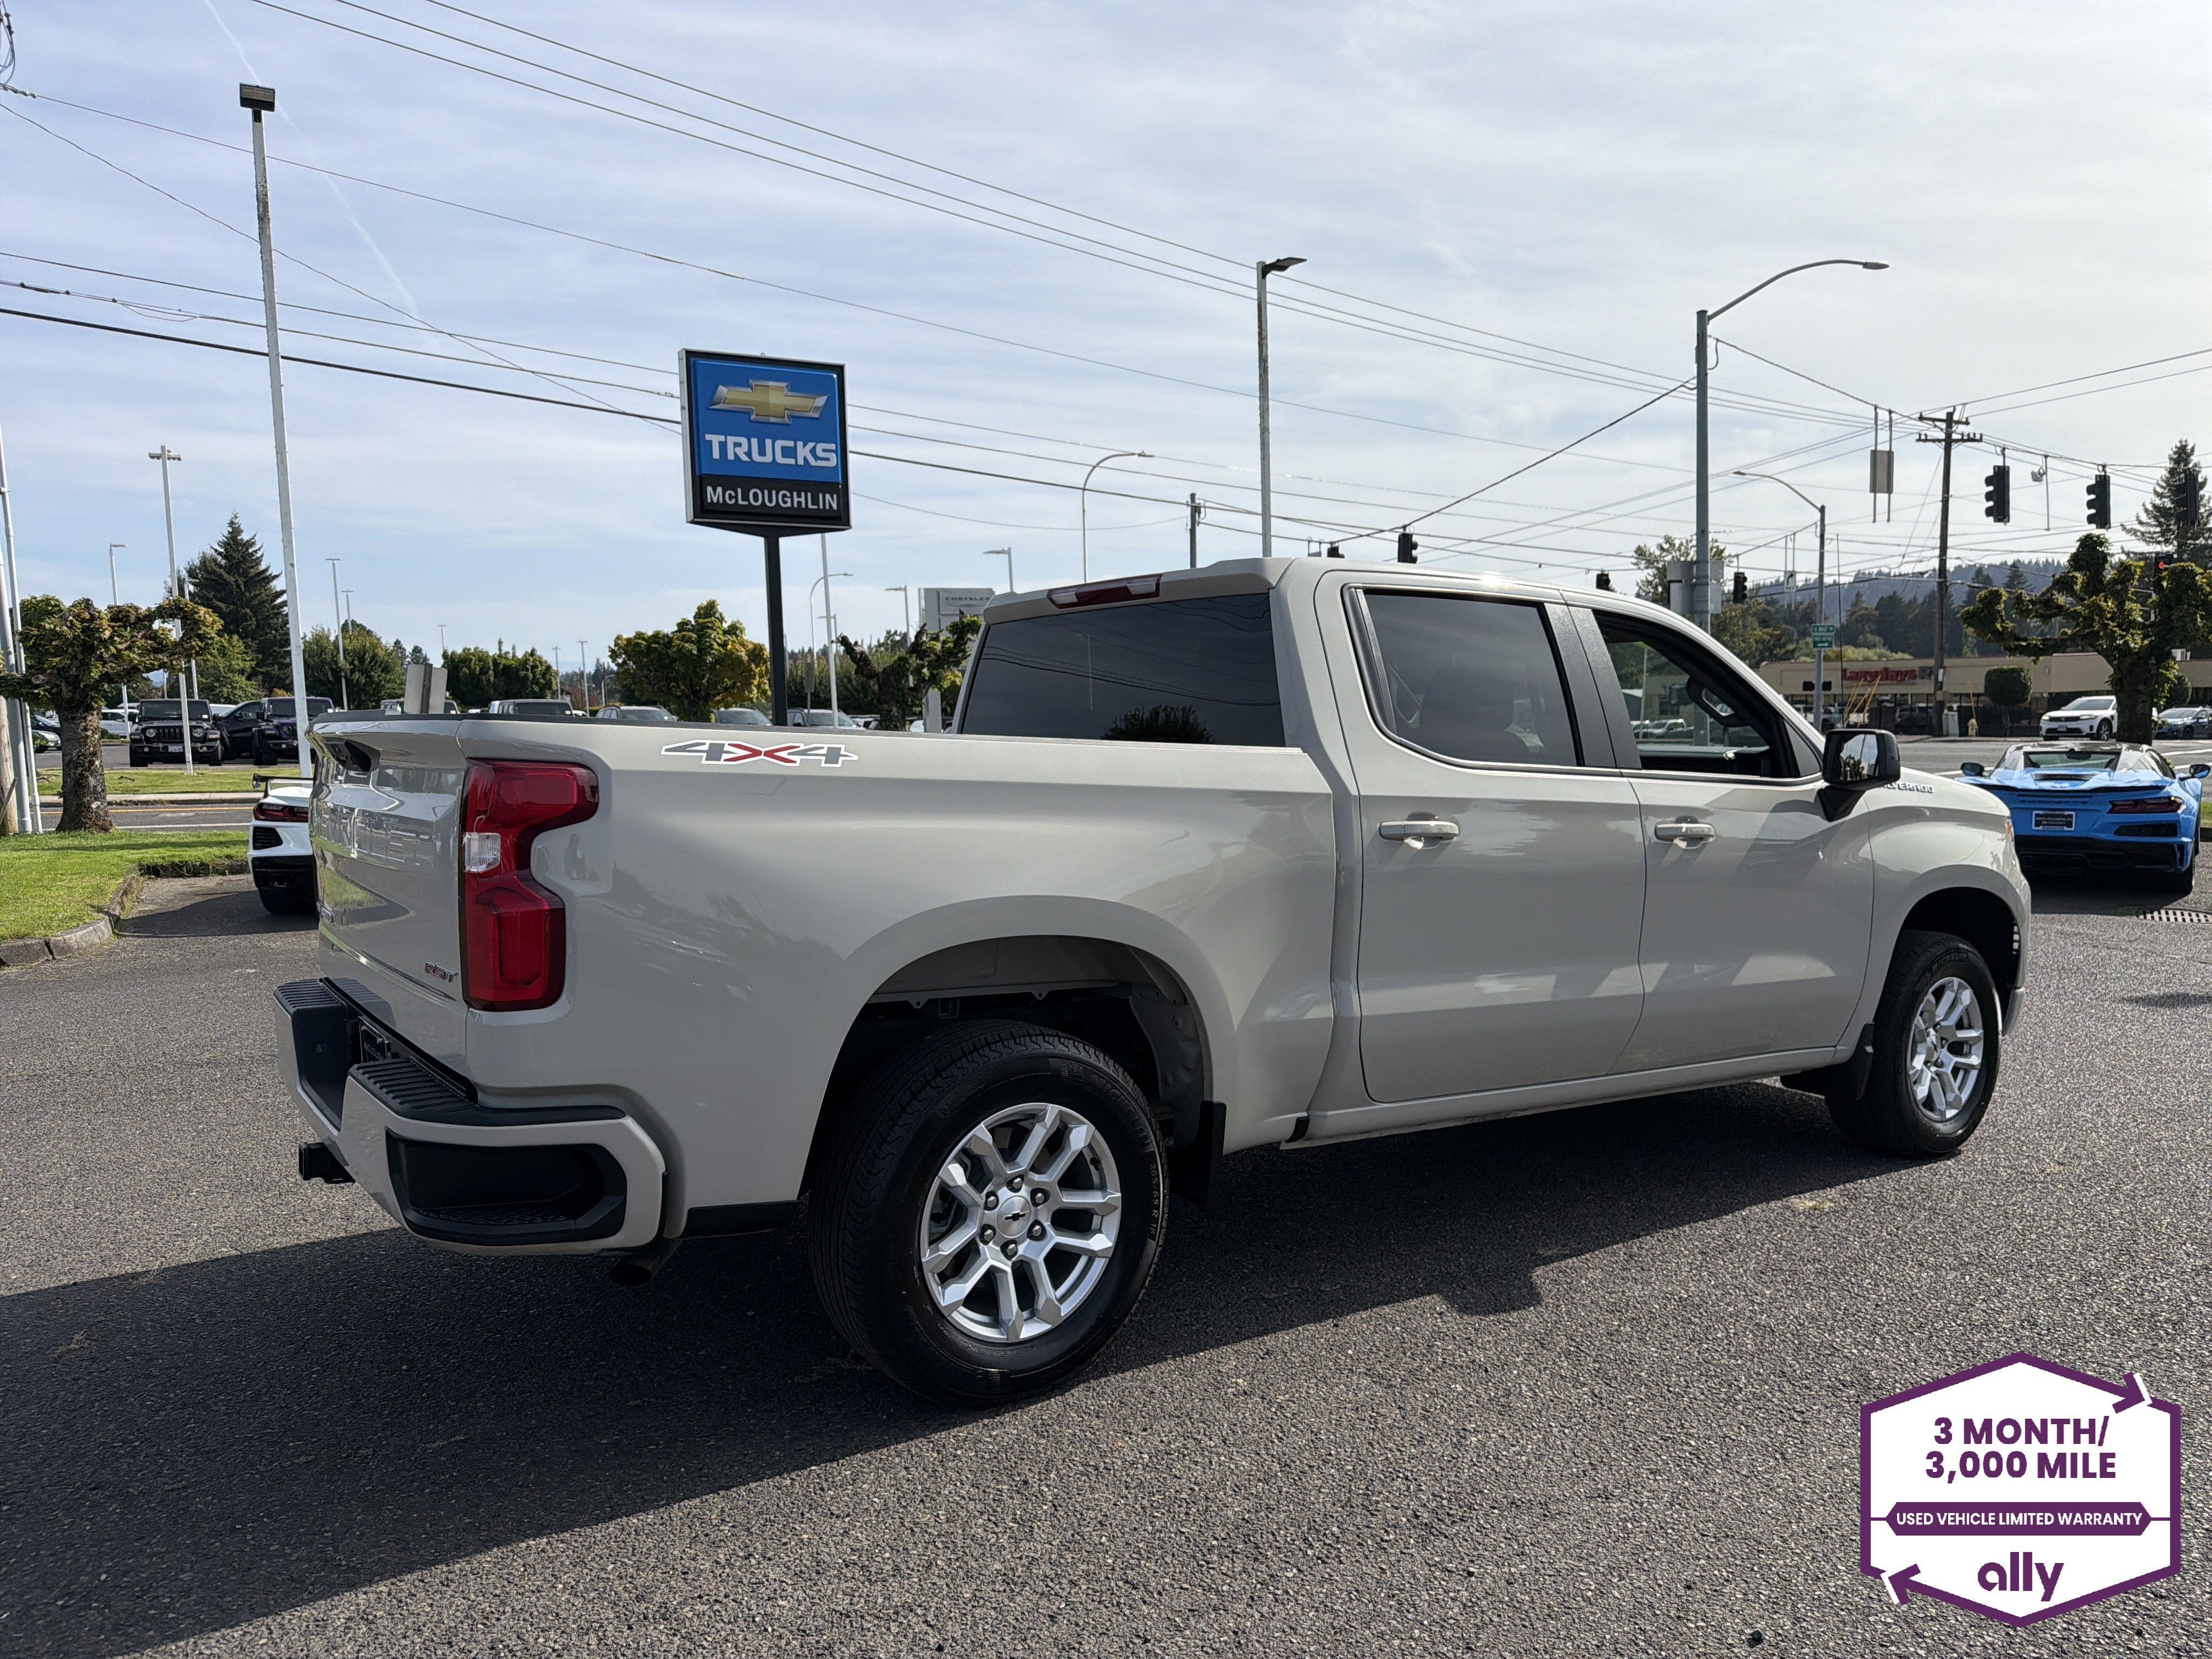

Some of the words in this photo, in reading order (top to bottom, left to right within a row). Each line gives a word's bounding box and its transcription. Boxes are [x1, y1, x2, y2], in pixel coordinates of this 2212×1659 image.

[705, 435, 837, 467] TRUCKS
[707, 486, 837, 510] McLOUGHLIN
[1843, 667, 1917, 682] Lazydays
[661, 740, 859, 768] 4X4
[425, 961, 458, 983] RST
